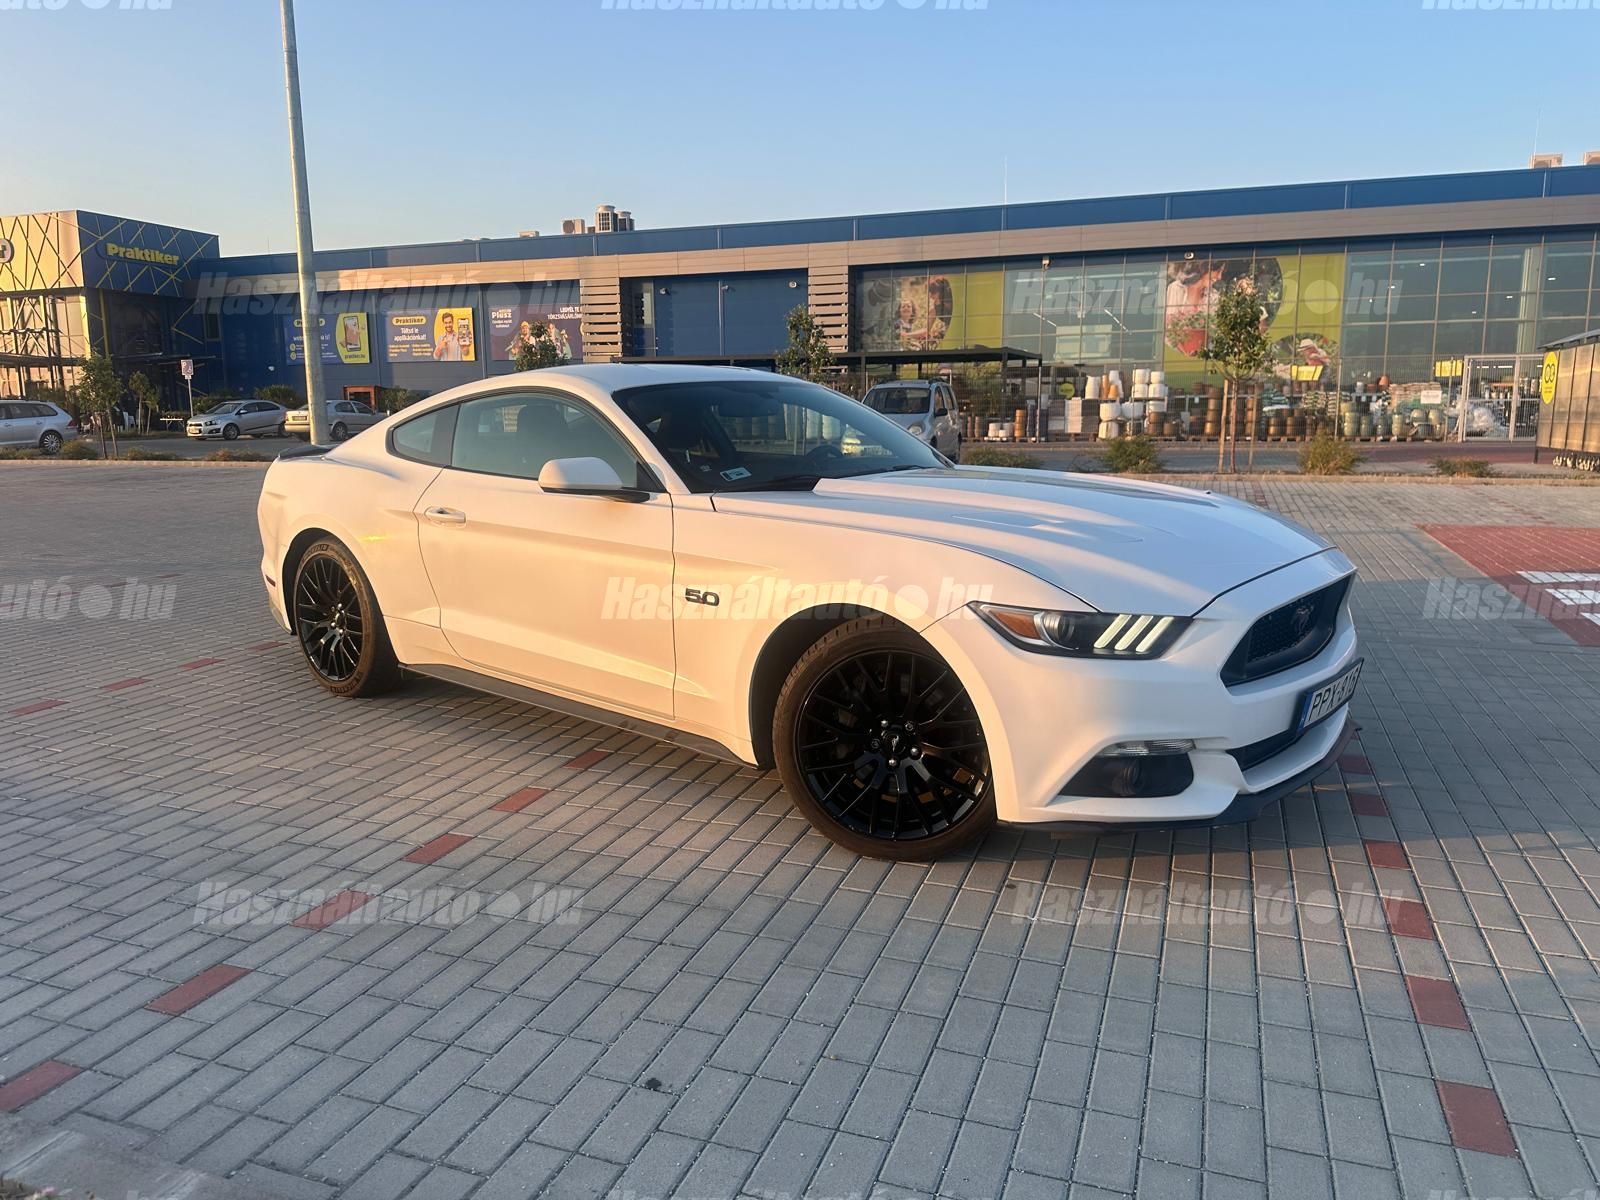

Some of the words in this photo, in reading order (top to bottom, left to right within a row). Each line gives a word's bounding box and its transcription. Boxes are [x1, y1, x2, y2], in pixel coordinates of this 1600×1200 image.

[106, 243, 179, 265] Praktiker
[491, 311, 513, 319] Plusz
[395, 317, 424, 325] Praktiker
